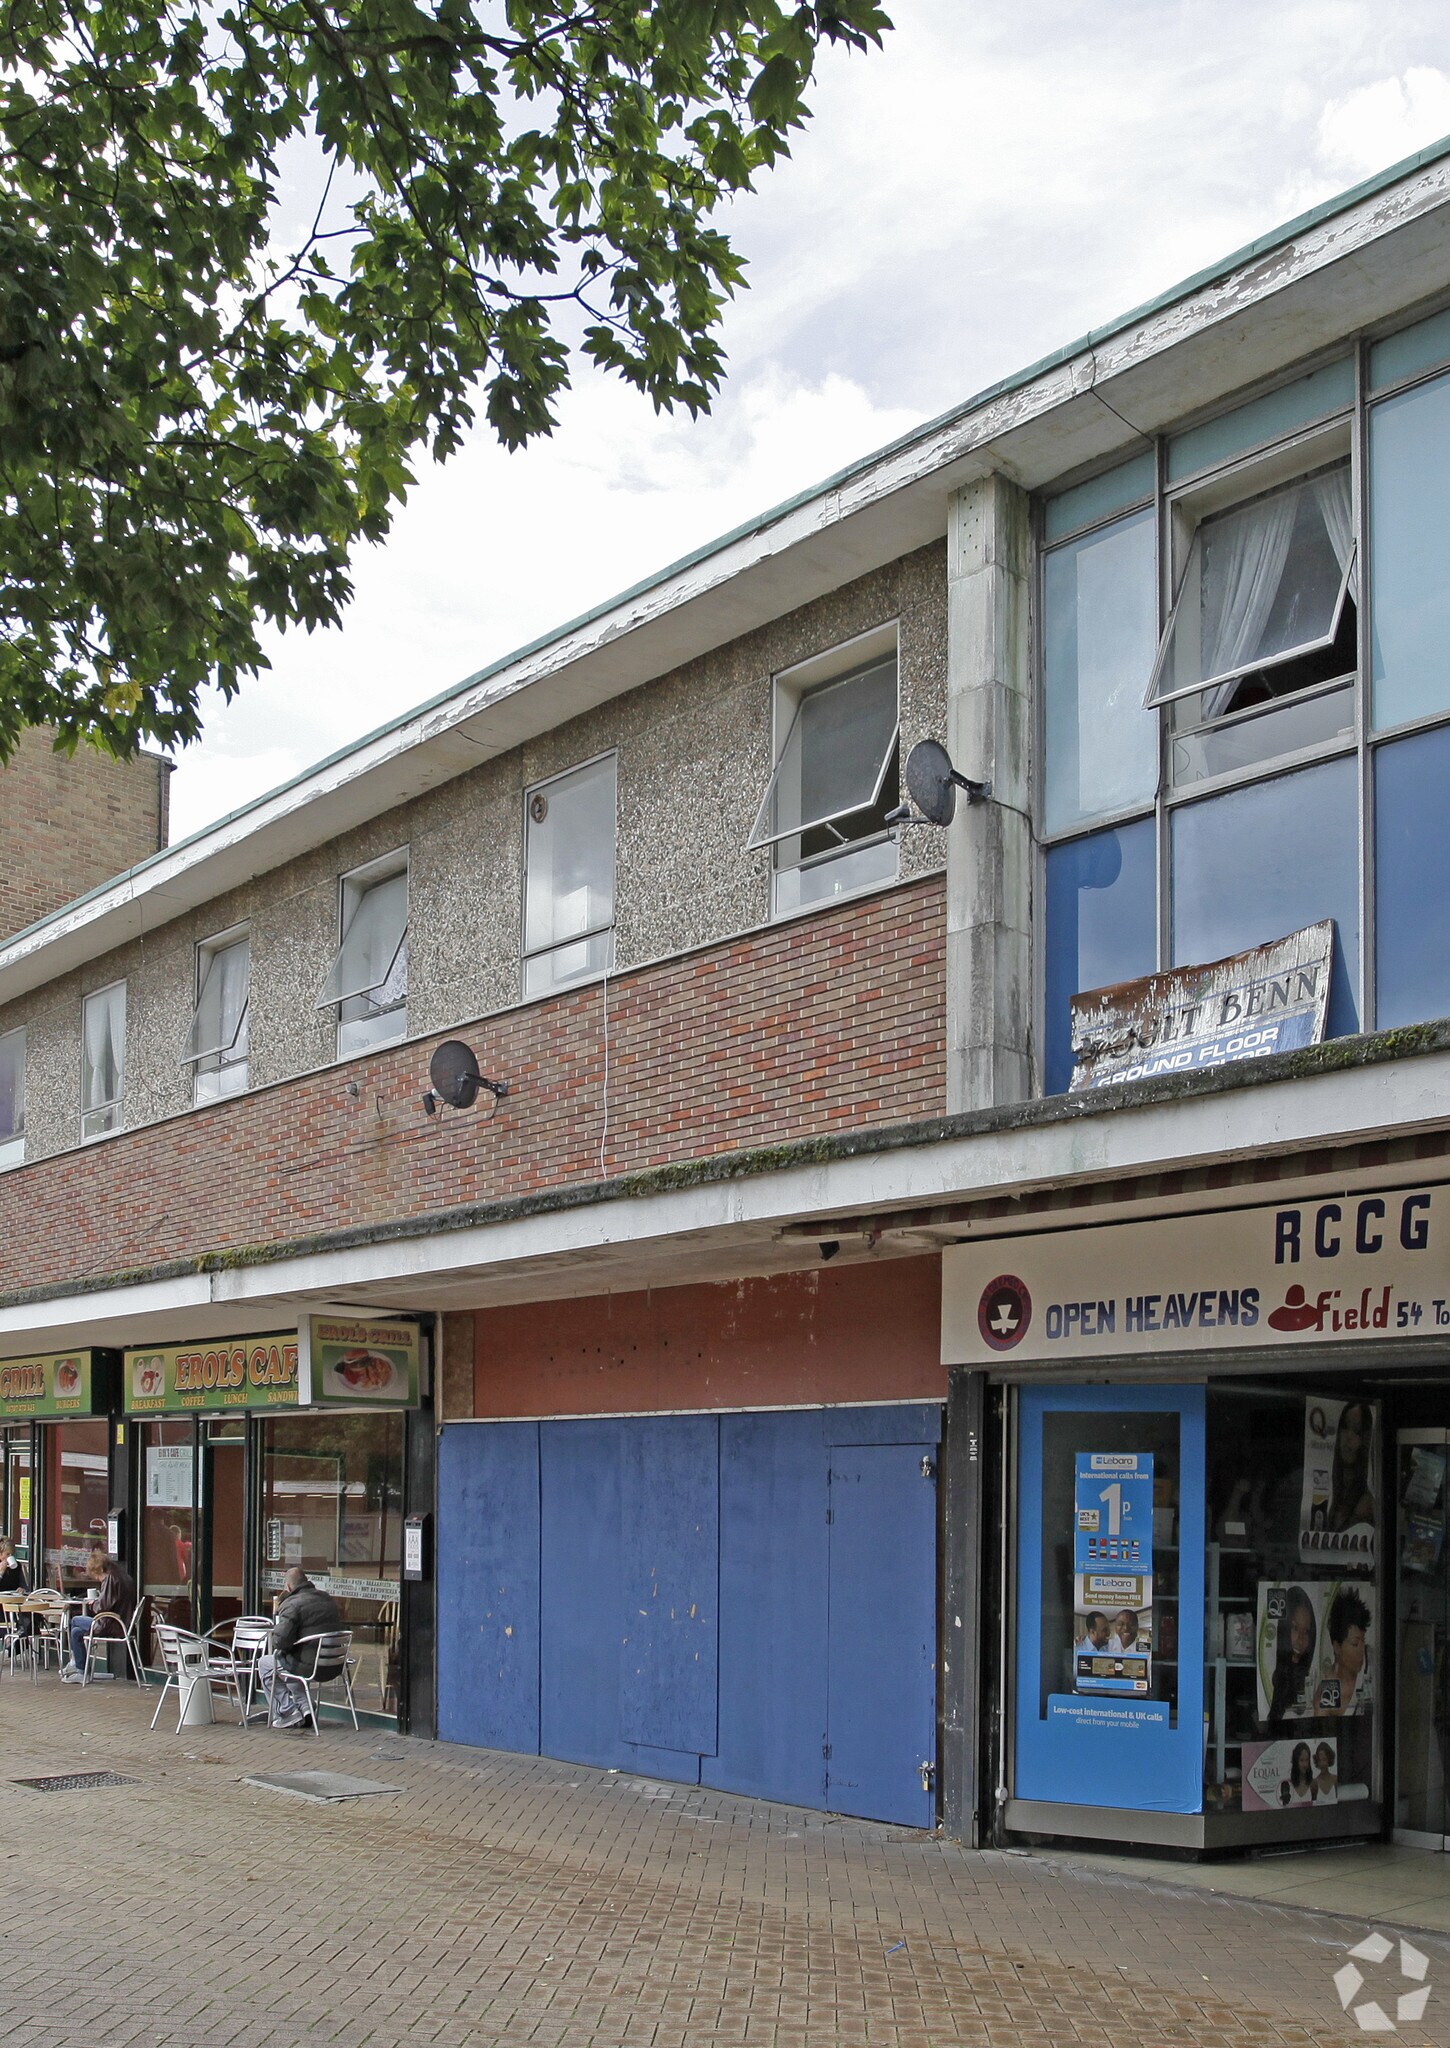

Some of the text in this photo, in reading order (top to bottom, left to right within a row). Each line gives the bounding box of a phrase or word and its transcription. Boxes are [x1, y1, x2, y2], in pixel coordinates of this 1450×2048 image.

[1216, 966, 1321, 1027] BENN
[1097, 1051, 1192, 1087] GROUND
[1199, 1026, 1279, 1061] FLOOR
[1275, 1194, 1431, 1264] RCCG
[1046, 1300, 1116, 1339] OPEN
[1125, 1287, 1260, 1333] HEAVENS
[1397, 1302, 1423, 1328] 54
[317, 1322, 412, 1346] EROL'S GRILL
[175, 1343, 299, 1391] EROL'S CAF
[0, 1364, 44, 1398] GRILL
[56, 1399, 80, 1409] BURGERS
[131, 1398, 165, 1410] BREAKFAST
[181, 1395, 206, 1407] COFFEE
[223, 1393, 248, 1405] LUNCH
[1103, 1456, 1133, 1465] Lebara
[1080, 1472, 1149, 1480] International calls from
[1102, 1578, 1132, 1588] Lebara
[1053, 1705, 1084, 1716] Low-cost
[1129, 1711, 1135, 1719] &
[1135, 1712, 1147, 1720] UK
[1147, 1713, 1163, 1722] calls
[1092, 1718, 1106, 1726] from
[1120, 1721, 1140, 1729] mobile
[1253, 1767, 1280, 1780] EQUAL
